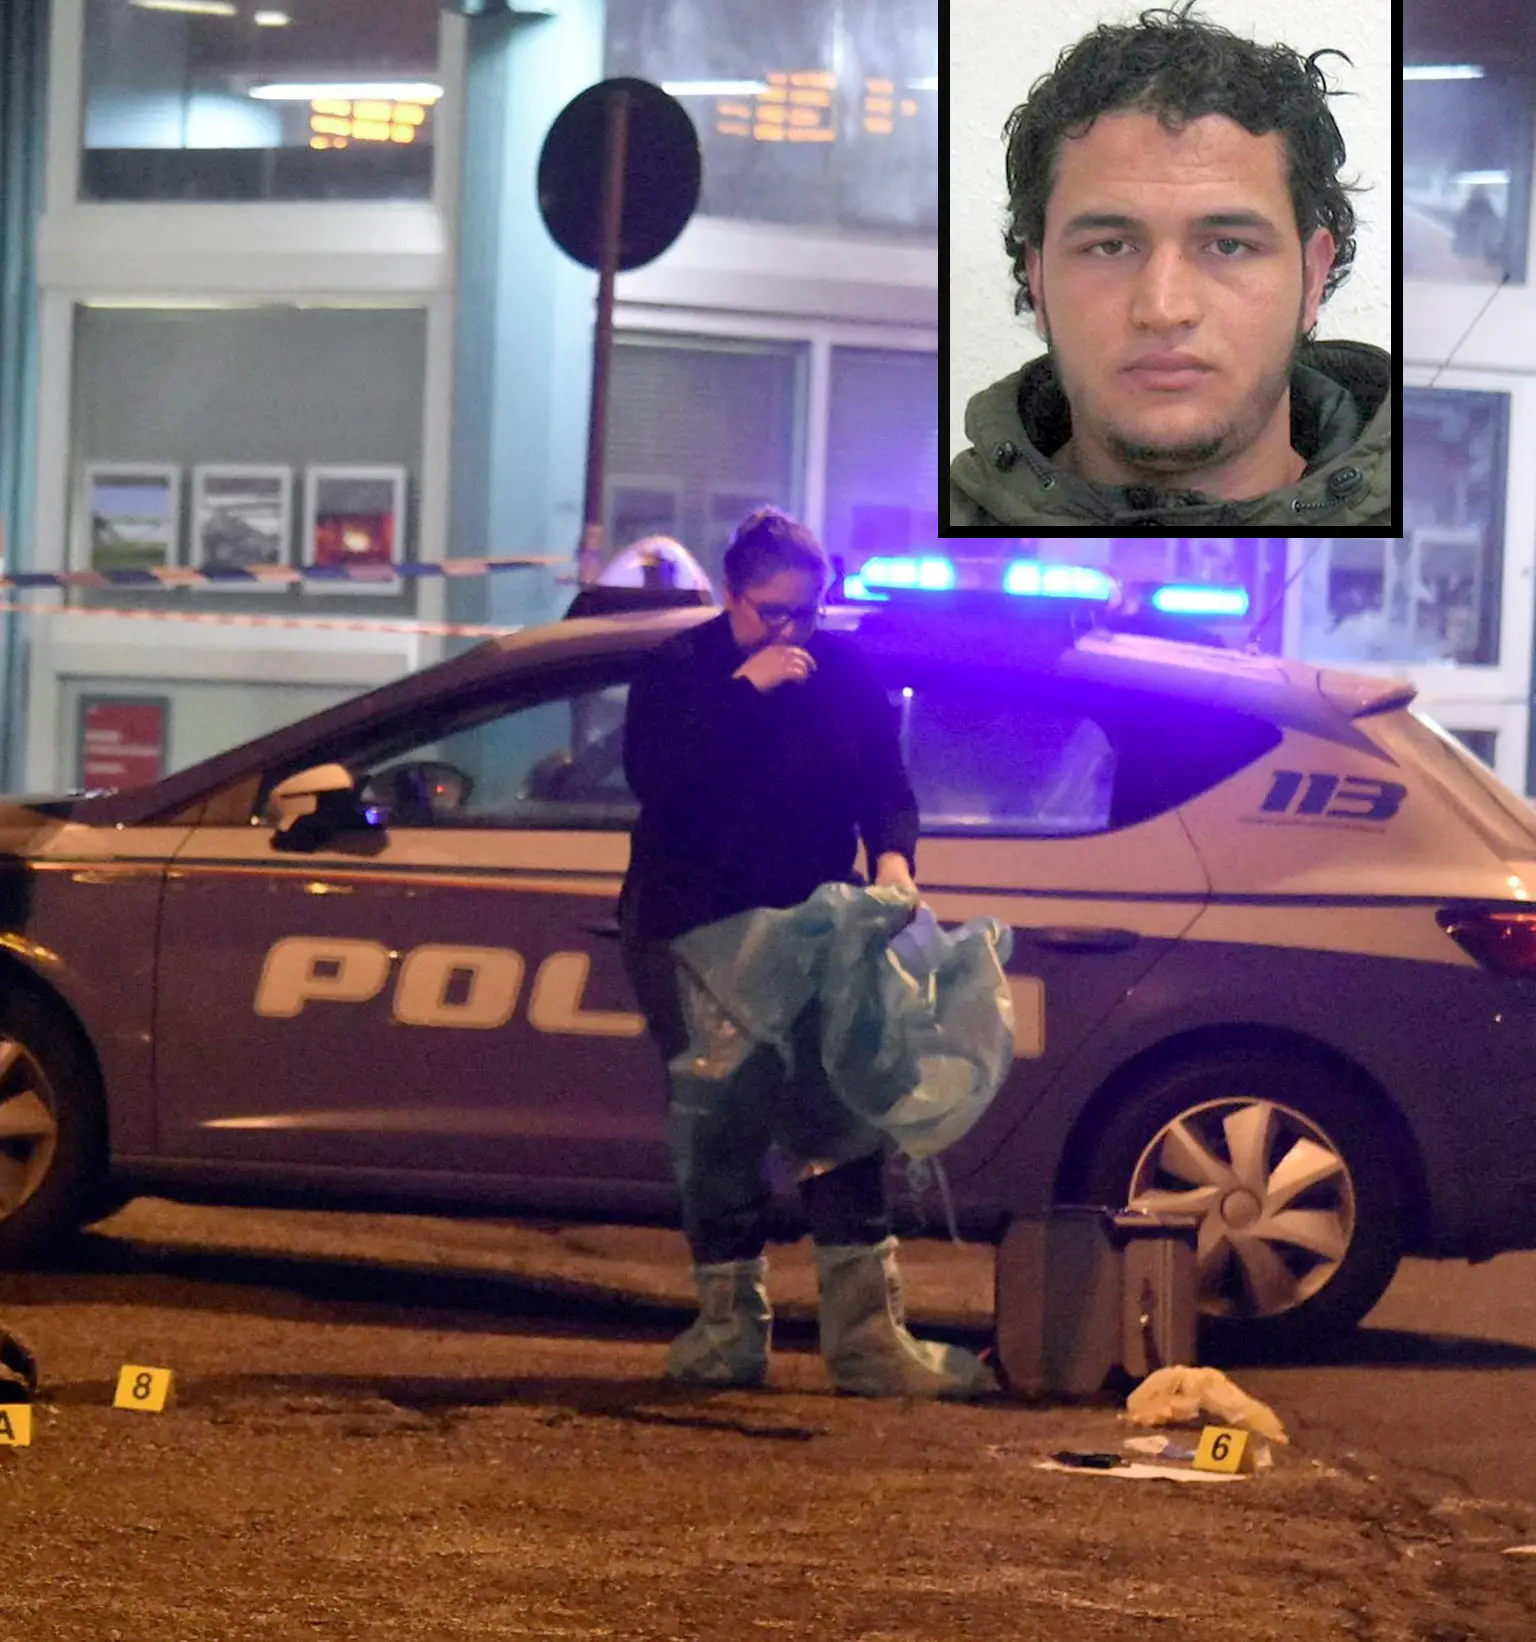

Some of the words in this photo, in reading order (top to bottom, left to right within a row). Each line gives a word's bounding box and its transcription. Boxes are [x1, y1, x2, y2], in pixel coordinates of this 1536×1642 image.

[1260, 769, 1407, 822] 113
[132, 1372, 153, 1400] 8
[1211, 1433, 1232, 1462] 6
